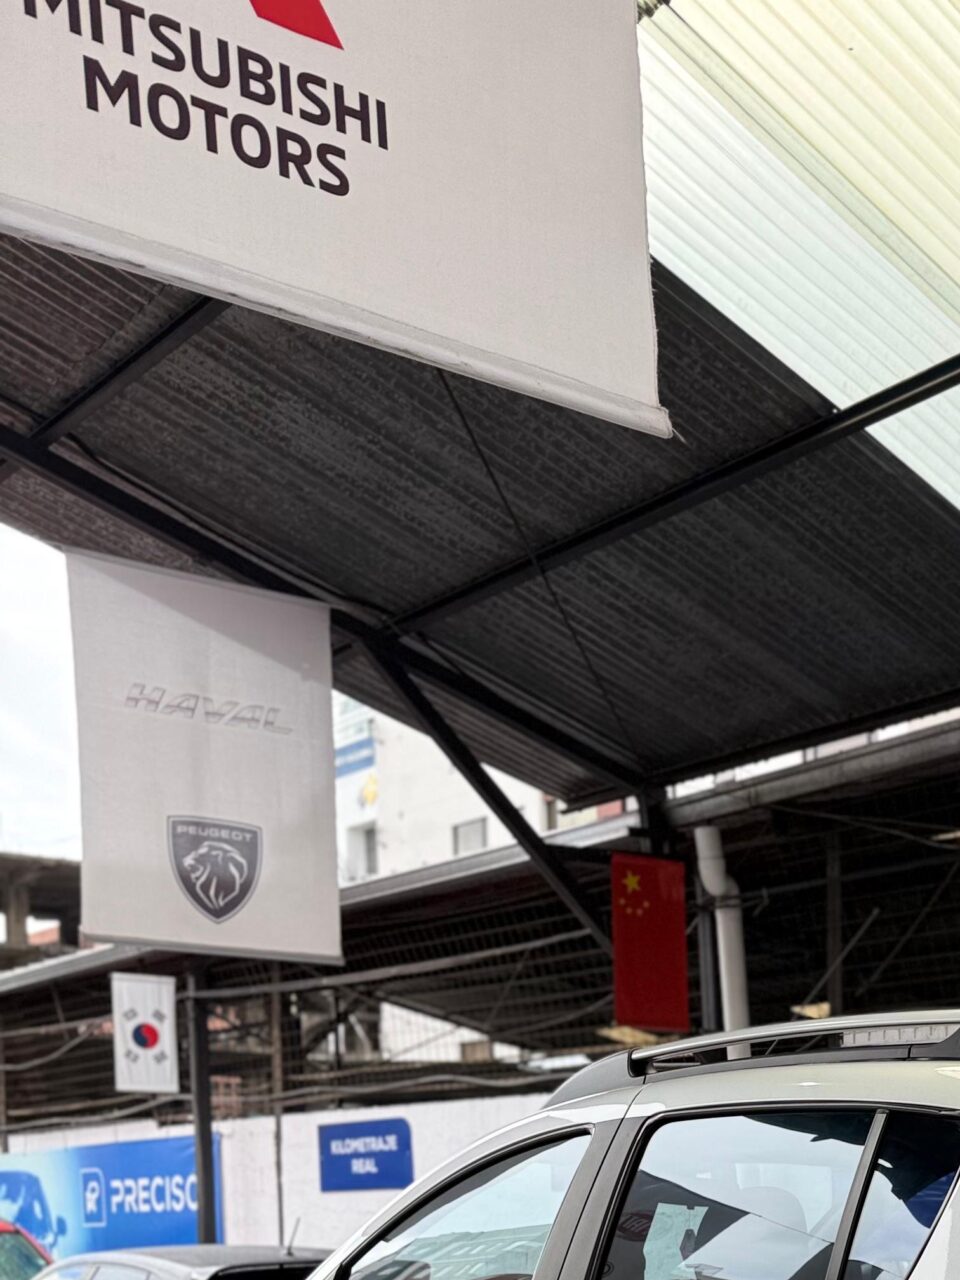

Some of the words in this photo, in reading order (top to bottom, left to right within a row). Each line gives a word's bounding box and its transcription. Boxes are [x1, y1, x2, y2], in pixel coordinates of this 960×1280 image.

[82, 54, 350, 196] MOTORS
[124, 682, 293, 735] HAVAL
[176, 825, 253, 842] PEUGEOT
[351, 1158, 379, 1174] REAL
